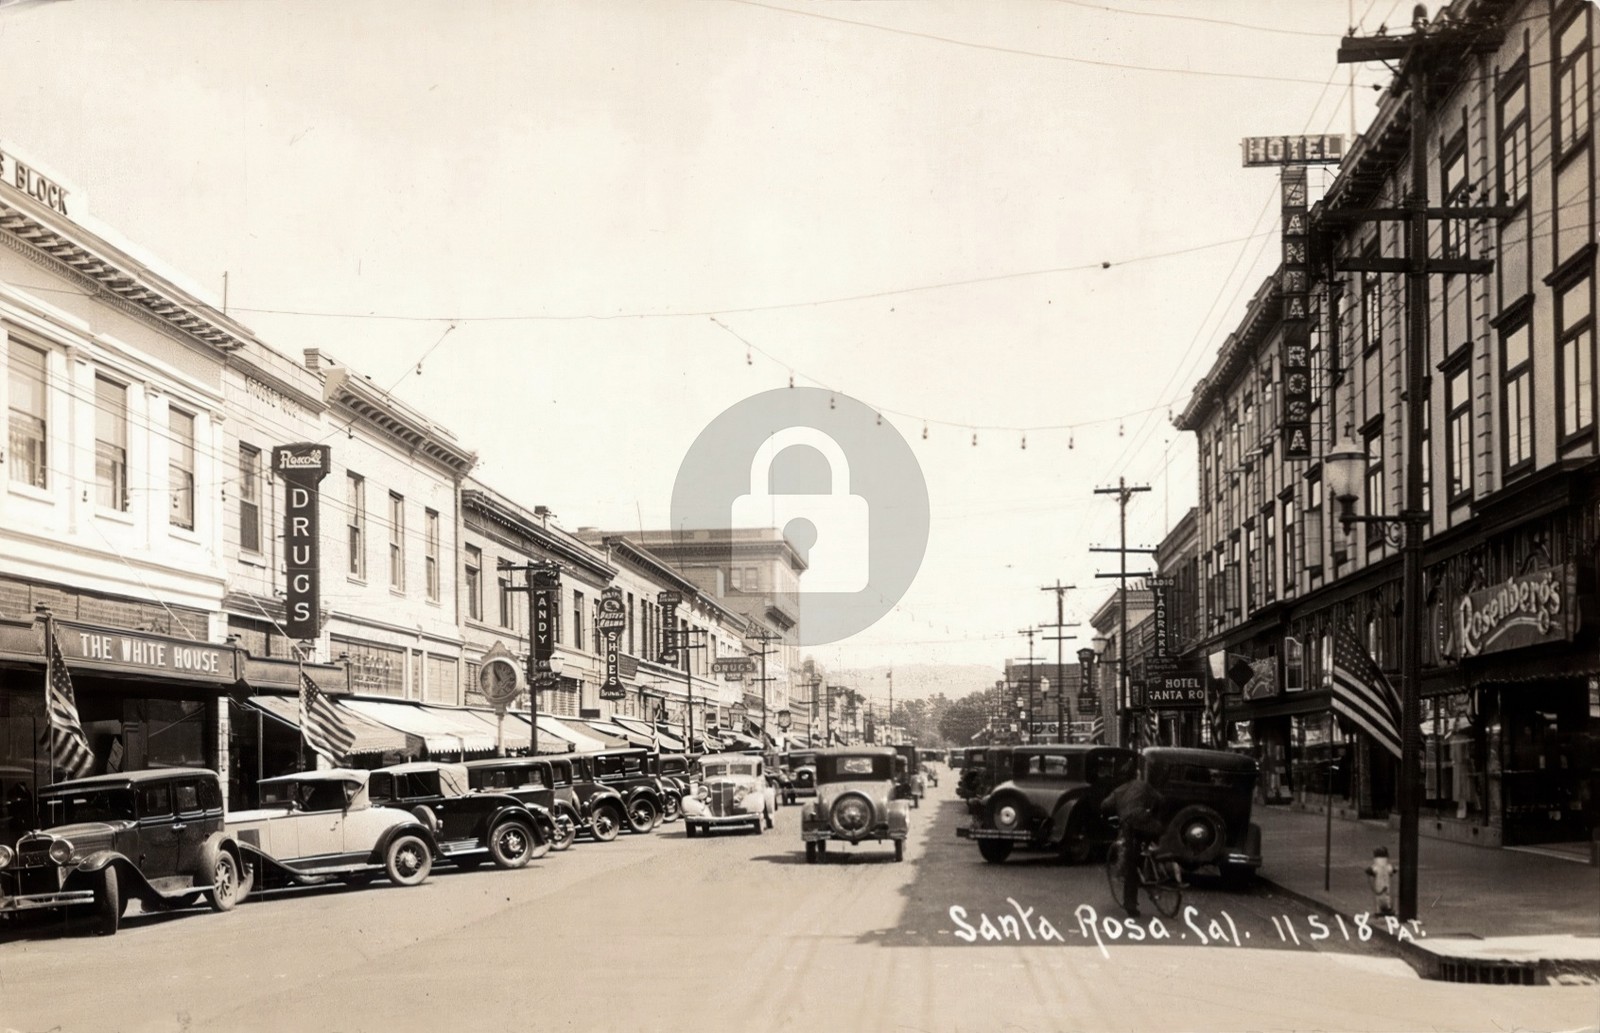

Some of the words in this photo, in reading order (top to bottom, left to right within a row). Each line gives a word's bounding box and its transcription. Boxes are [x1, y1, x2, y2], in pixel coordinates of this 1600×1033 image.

[1247, 137, 1342, 162] HOTEL
[15, 160, 69, 216] BLOCK
[1287, 345, 1308, 451] ROSA
[291, 488, 311, 622] DRUGS
[79, 633, 113, 660] THE
[121, 638, 167, 668] WHITE
[174, 647, 220, 673] HOUSE
[608, 631, 617, 686] SHOES
[1165, 678, 1201, 689] HOTEL
[1188, 690, 1205, 700] RO
